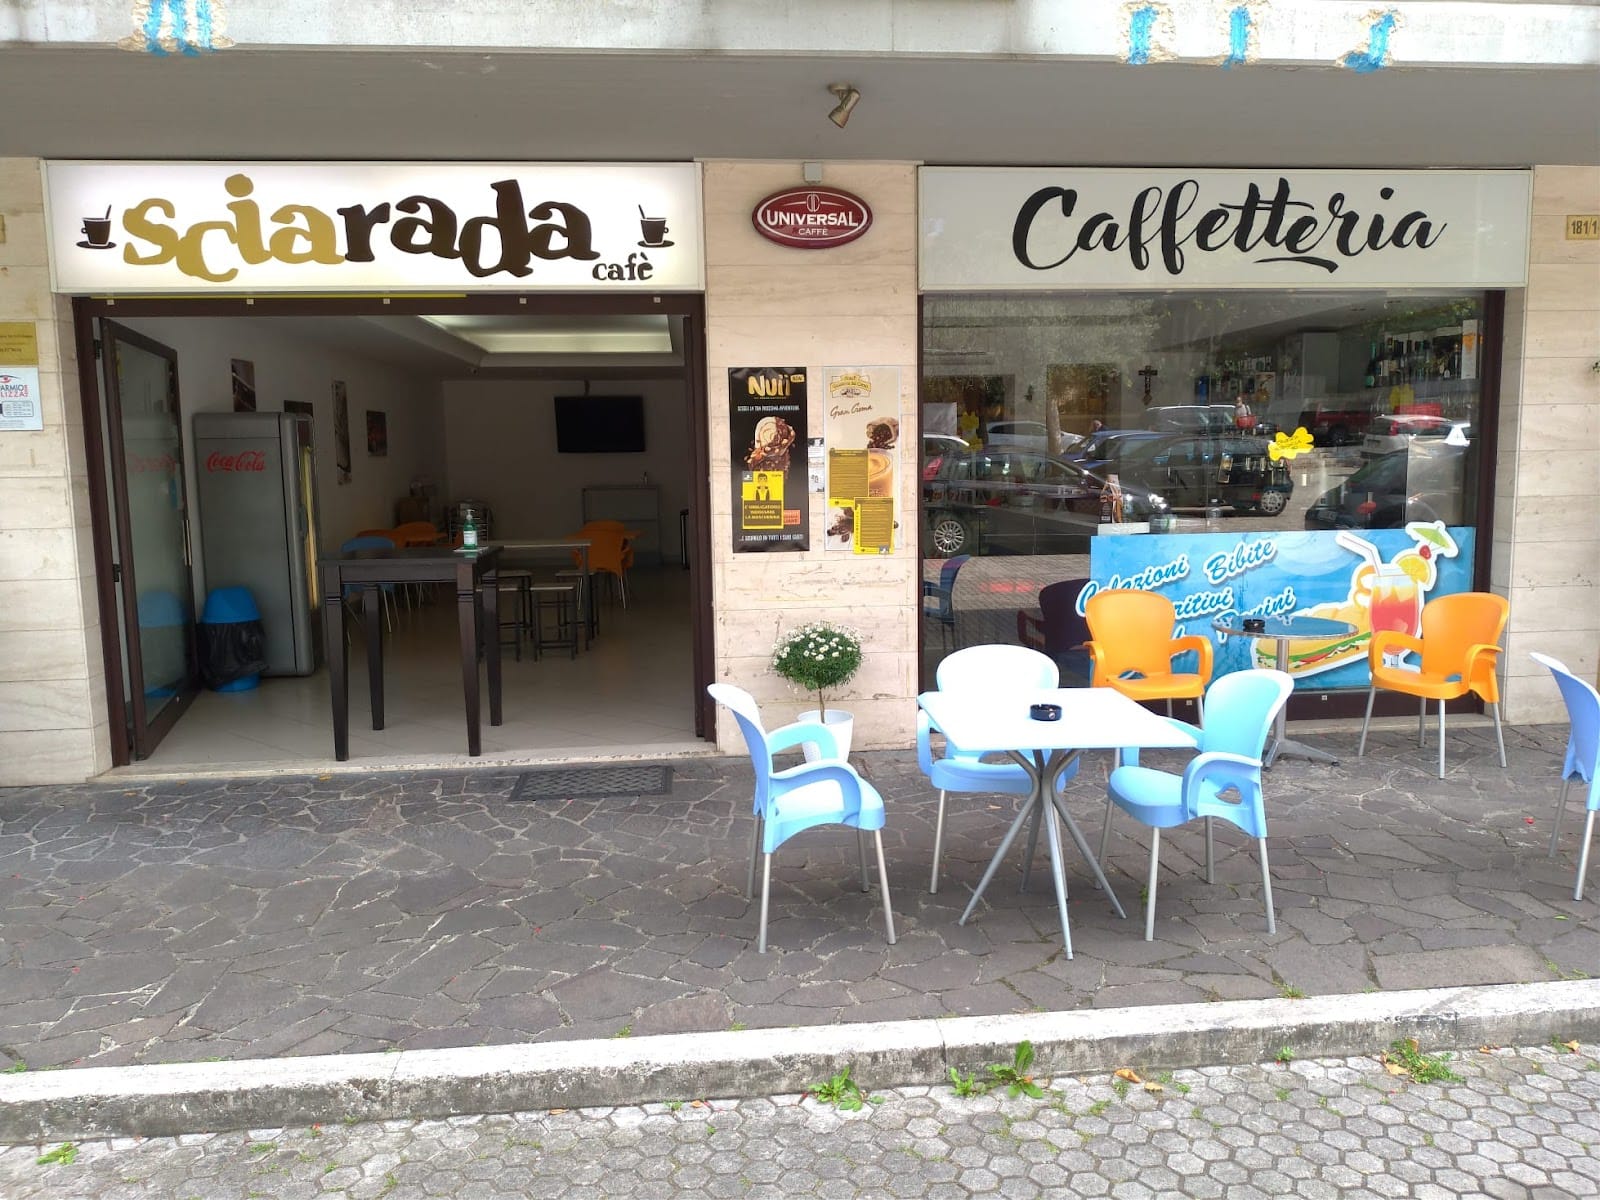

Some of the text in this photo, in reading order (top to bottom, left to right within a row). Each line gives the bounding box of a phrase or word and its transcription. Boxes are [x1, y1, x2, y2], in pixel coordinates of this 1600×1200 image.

[122, 174, 601, 283] sciarada
[766, 209, 859, 227] UNIVERSAL
[1012, 177, 1447, 275] Caffetteria
[592, 251, 653, 281] cafè
[747, 373, 791, 397] Nuii
[830, 405, 850, 420] Gran
[1206, 541, 1273, 581] Bibite
